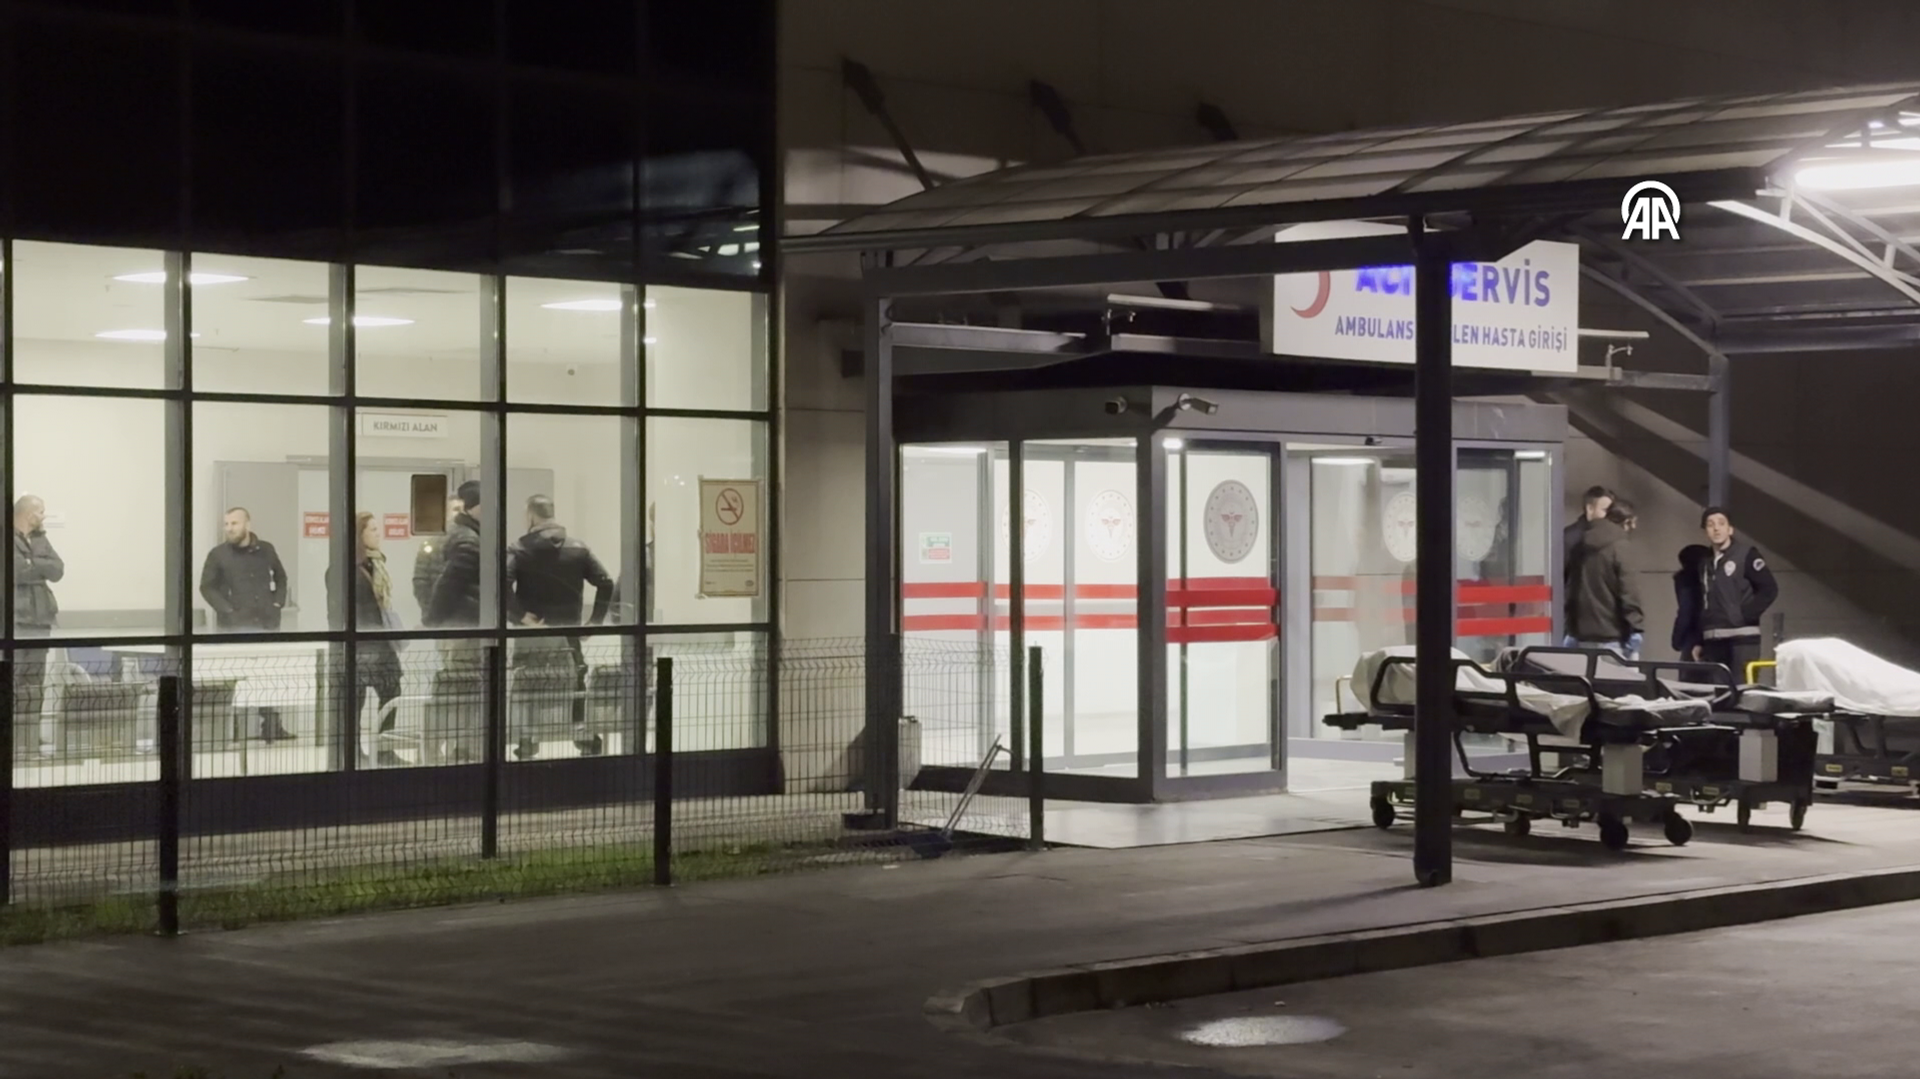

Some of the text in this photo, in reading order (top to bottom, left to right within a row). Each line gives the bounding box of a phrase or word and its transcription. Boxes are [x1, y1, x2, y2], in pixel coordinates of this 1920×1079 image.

[1335, 315, 1568, 353] AMBULANS LEN HASTA GİRİŞİ
[373, 420, 438, 433] KIRMIZI ALAN
